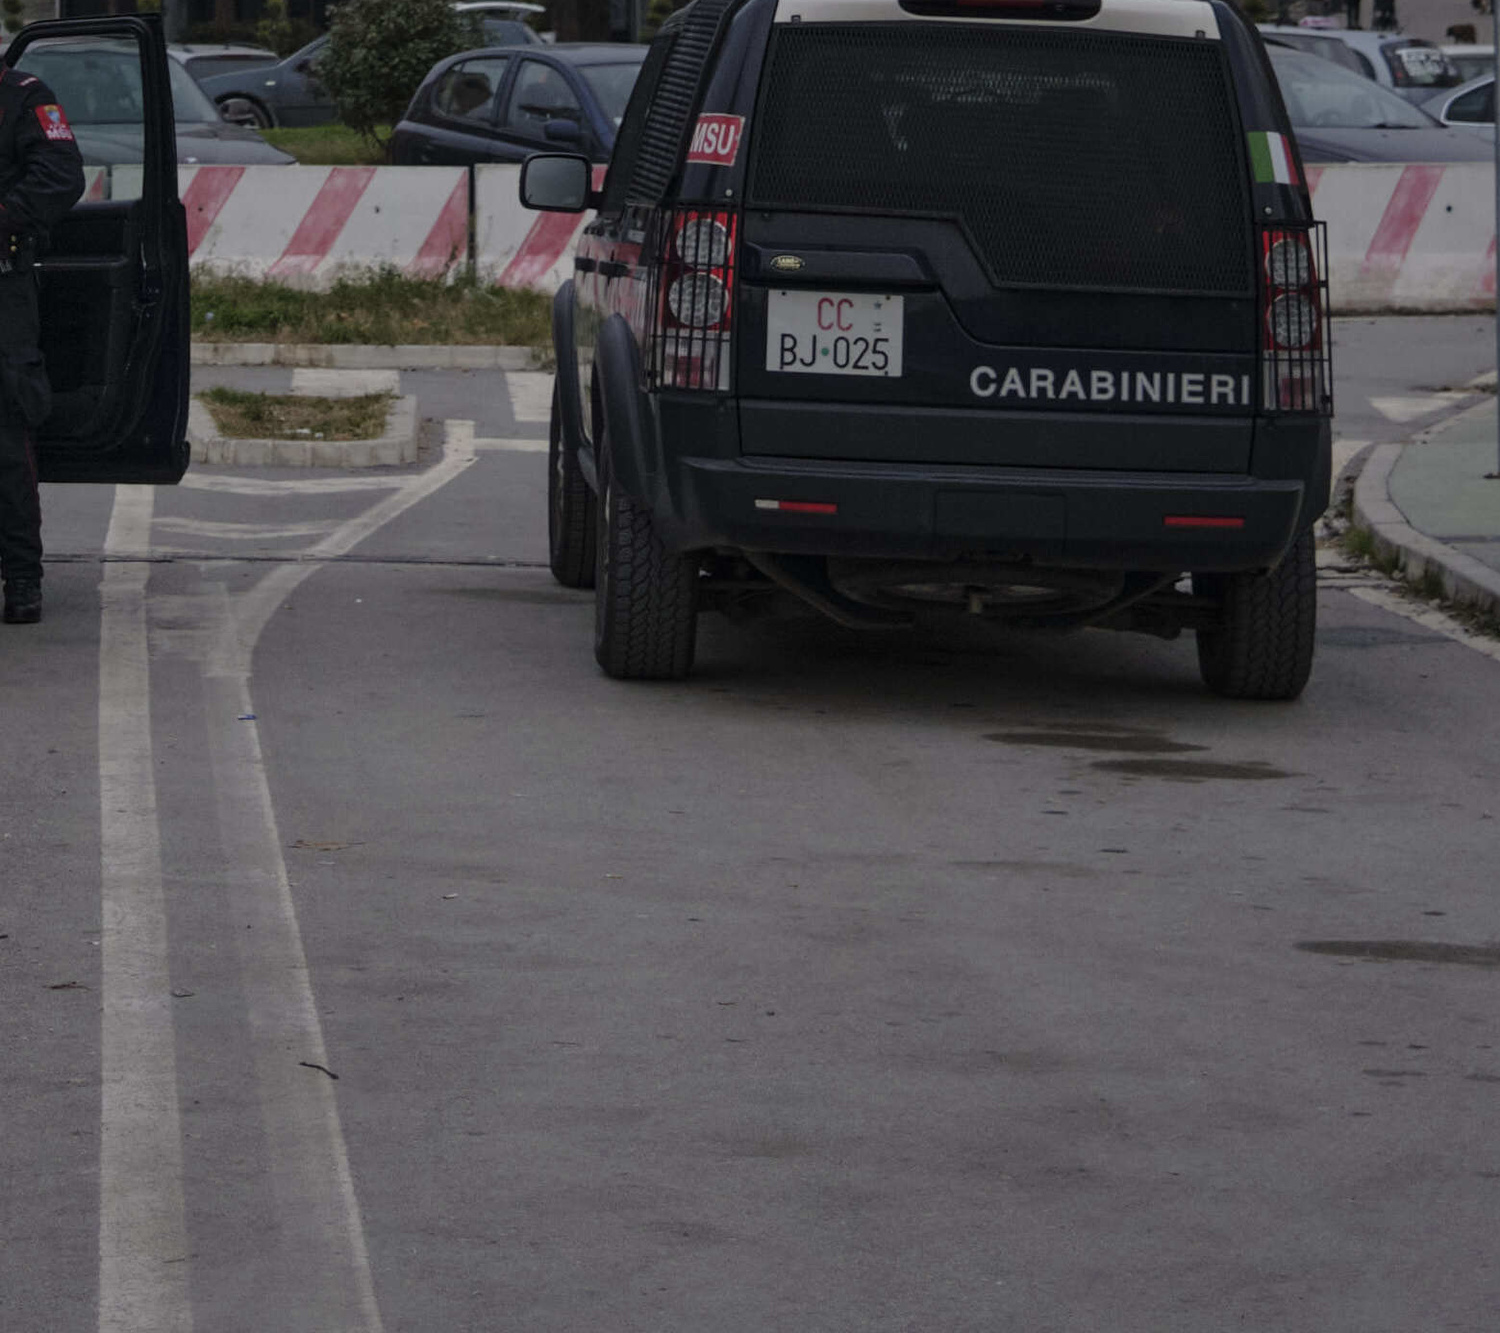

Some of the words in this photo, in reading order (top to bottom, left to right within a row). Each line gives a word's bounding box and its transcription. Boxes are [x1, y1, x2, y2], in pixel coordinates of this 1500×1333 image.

[689, 121, 736, 155] MSU
[817, 297, 854, 331] CC
[780, 333, 816, 368] BJ
[833, 336, 890, 370] 025
[969, 365, 1250, 405] CARABINIERI
